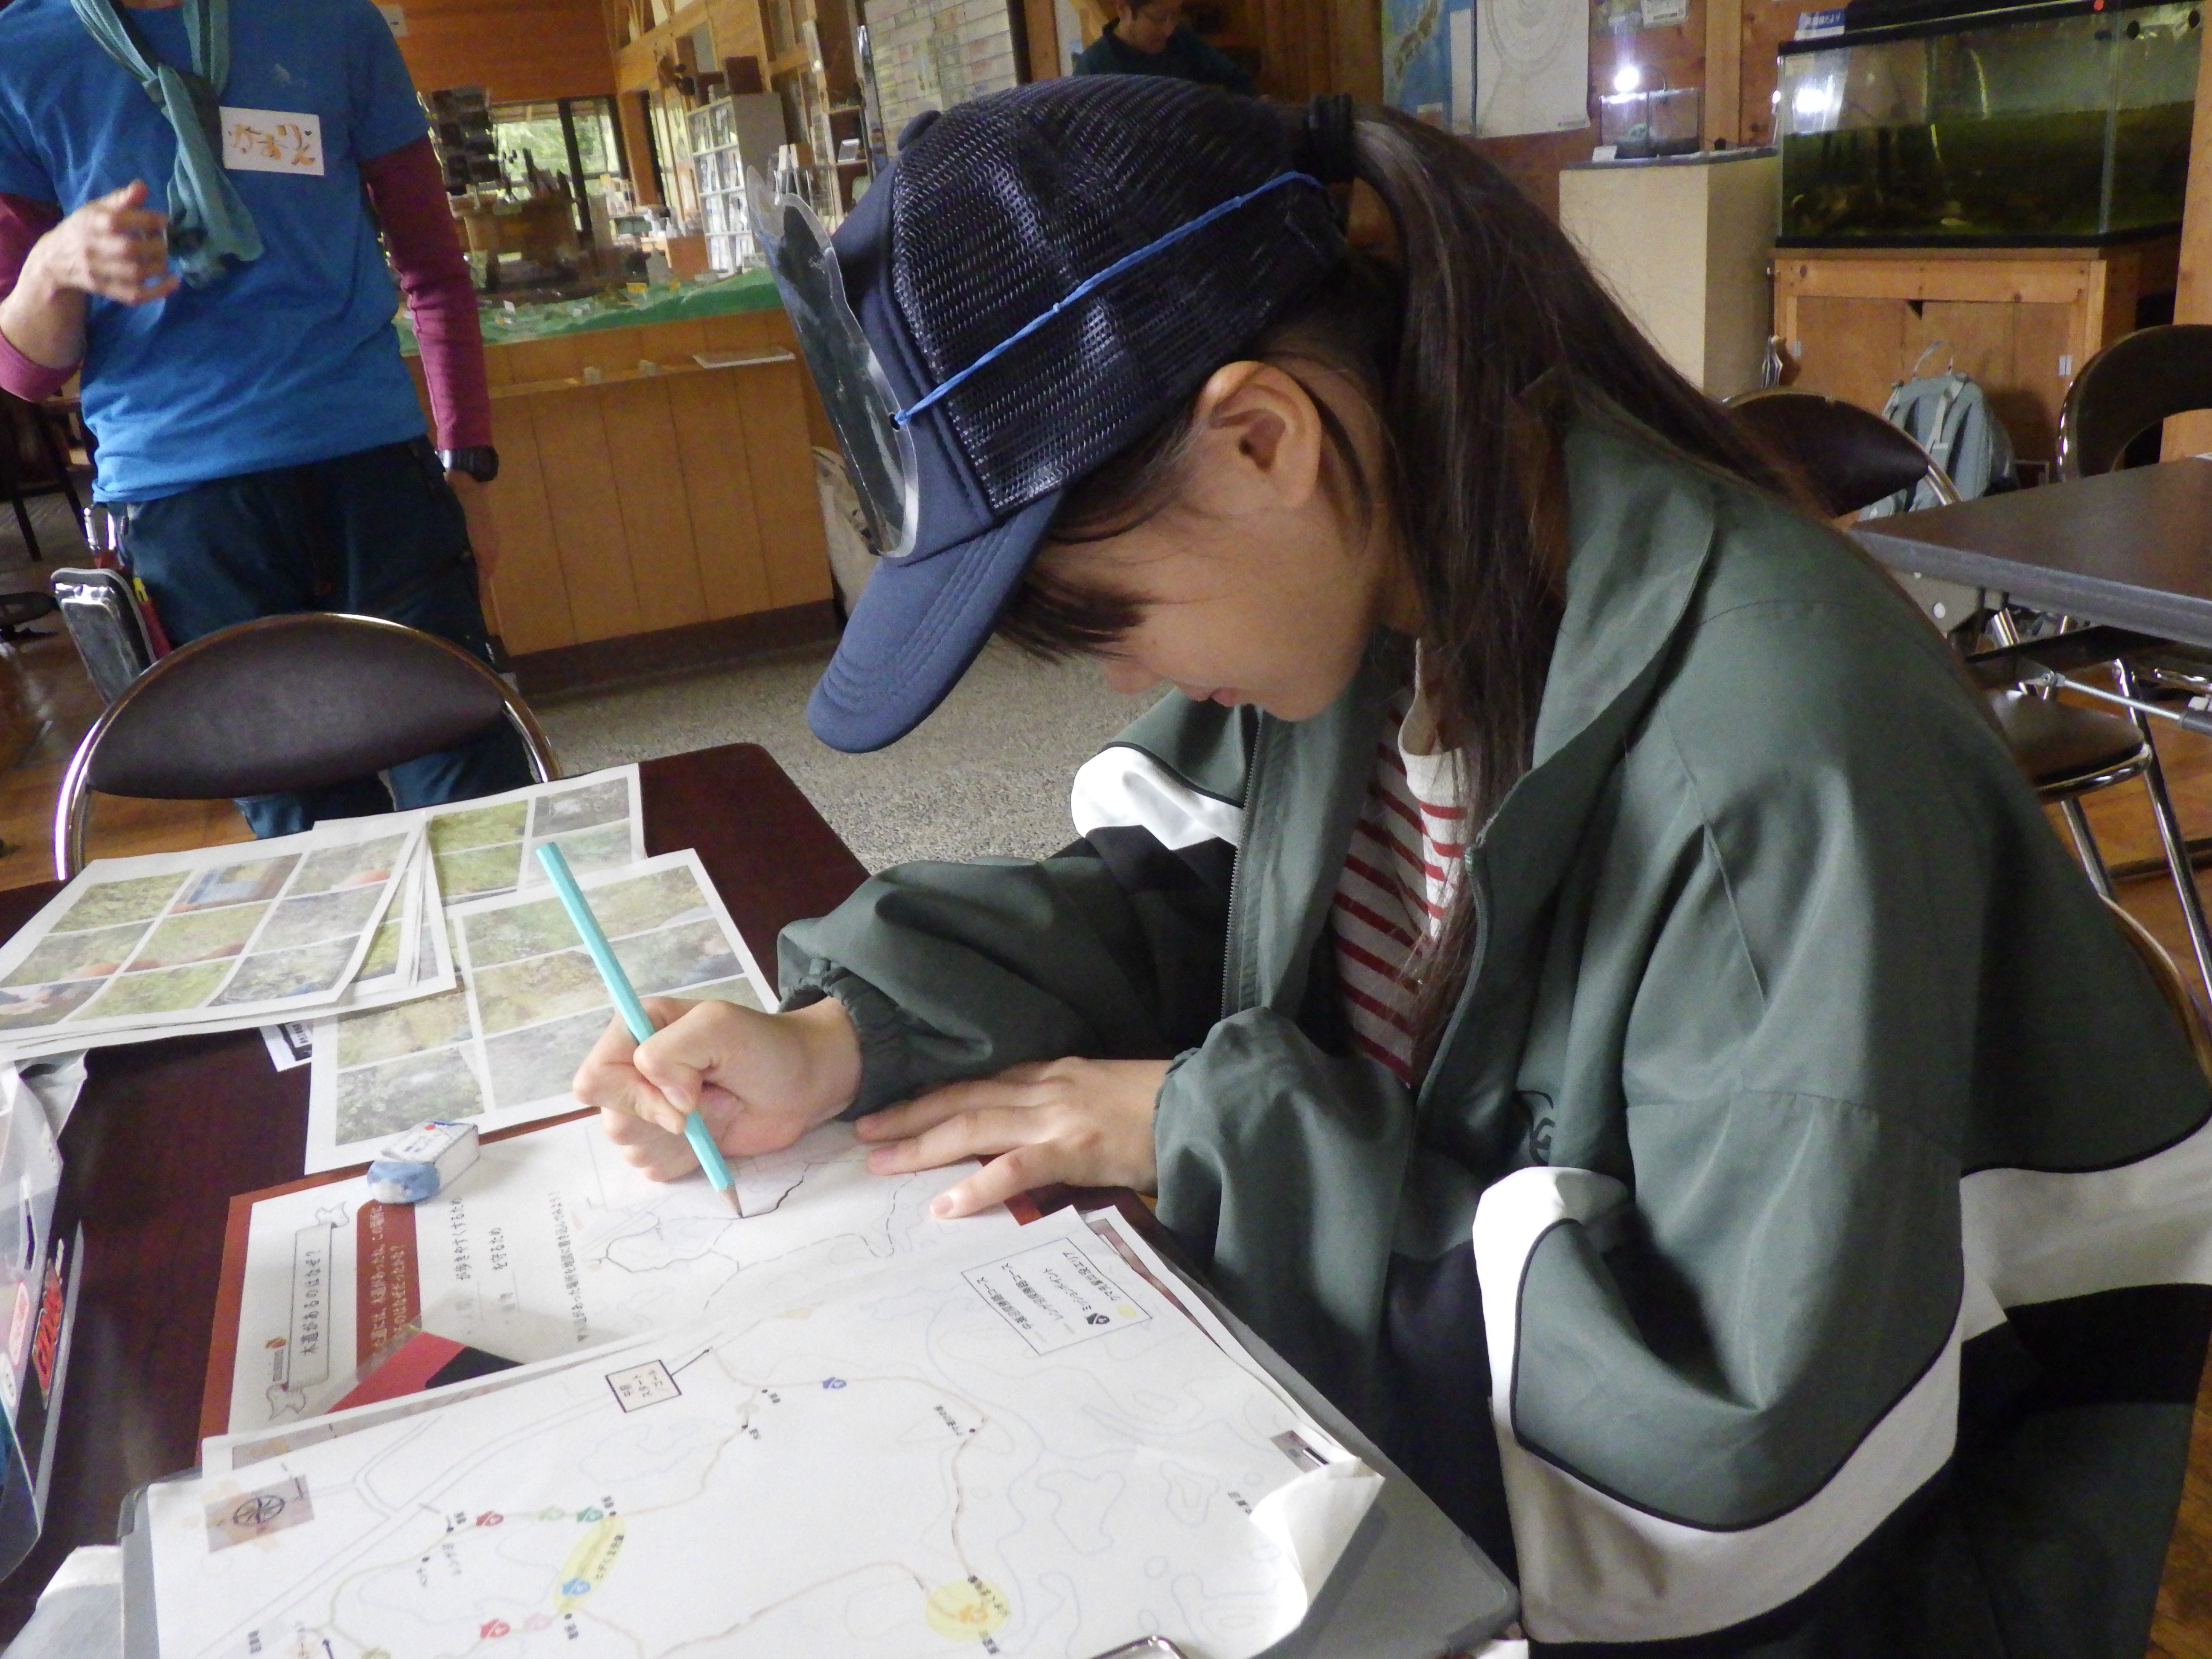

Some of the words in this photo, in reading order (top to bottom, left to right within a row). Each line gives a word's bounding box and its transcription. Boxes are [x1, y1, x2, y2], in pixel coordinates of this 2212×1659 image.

[489, 1227, 508, 1271] を守るため
